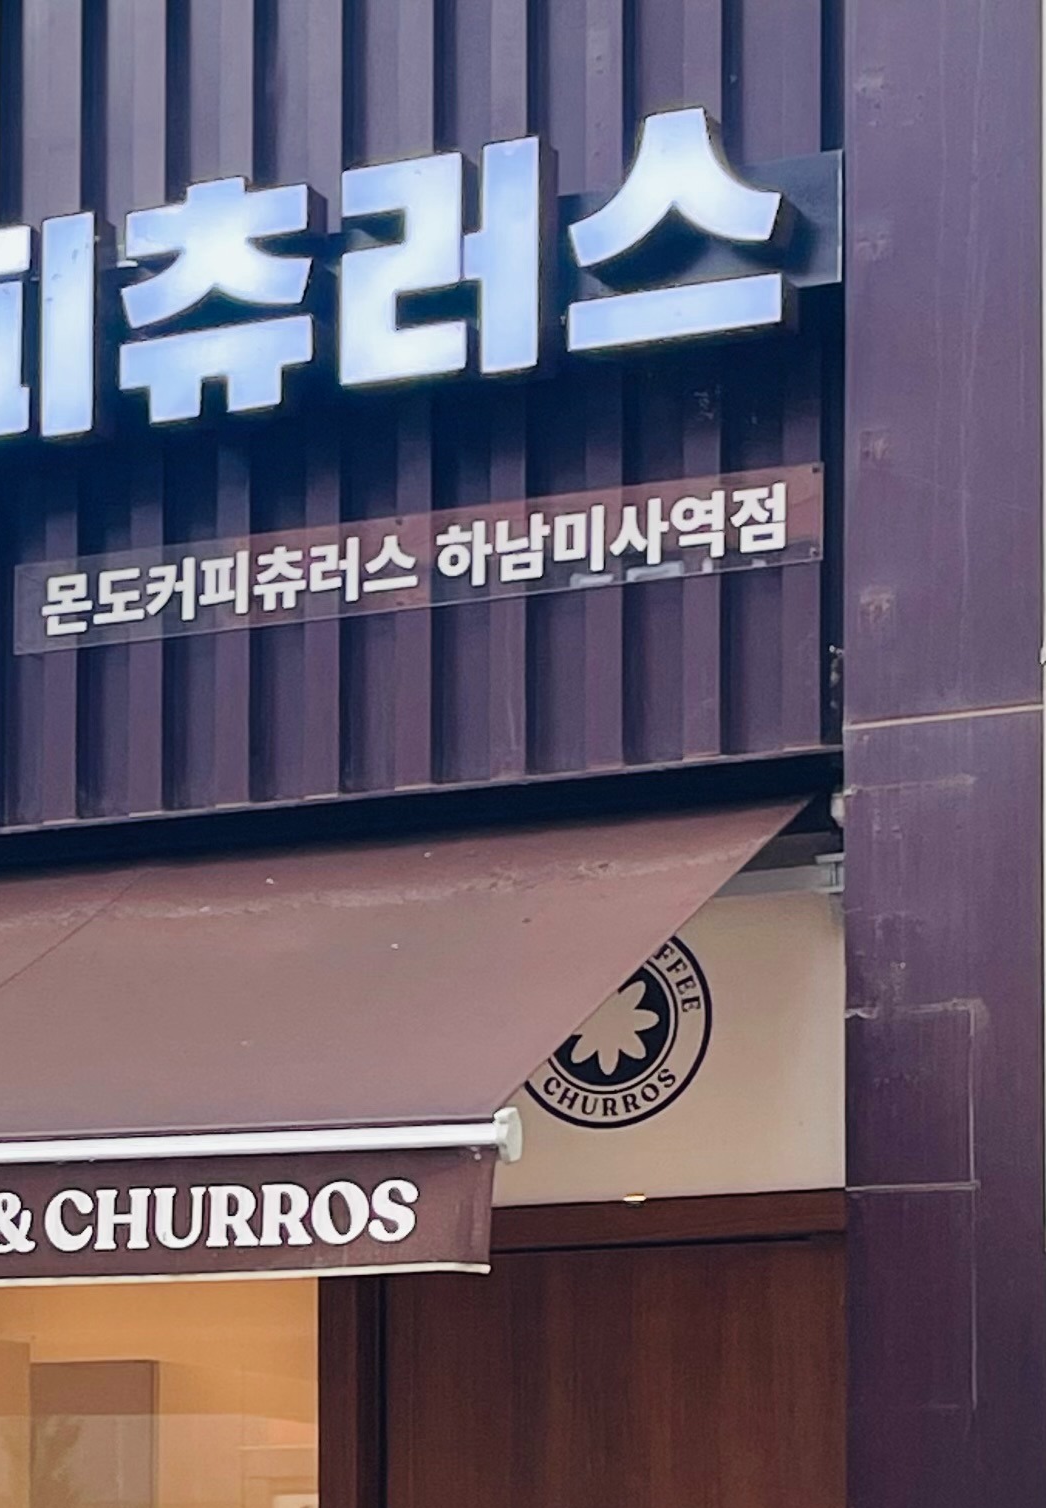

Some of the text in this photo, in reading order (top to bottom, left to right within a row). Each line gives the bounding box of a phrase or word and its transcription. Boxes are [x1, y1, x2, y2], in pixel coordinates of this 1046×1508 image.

[39, 482, 788, 637] 몬도커피츄러스 하남미사역점
[653, 943, 701, 1013] FFEE
[543, 1068, 677, 1117] CHURROS
[44, 1179, 420, 1252] CHURROS
